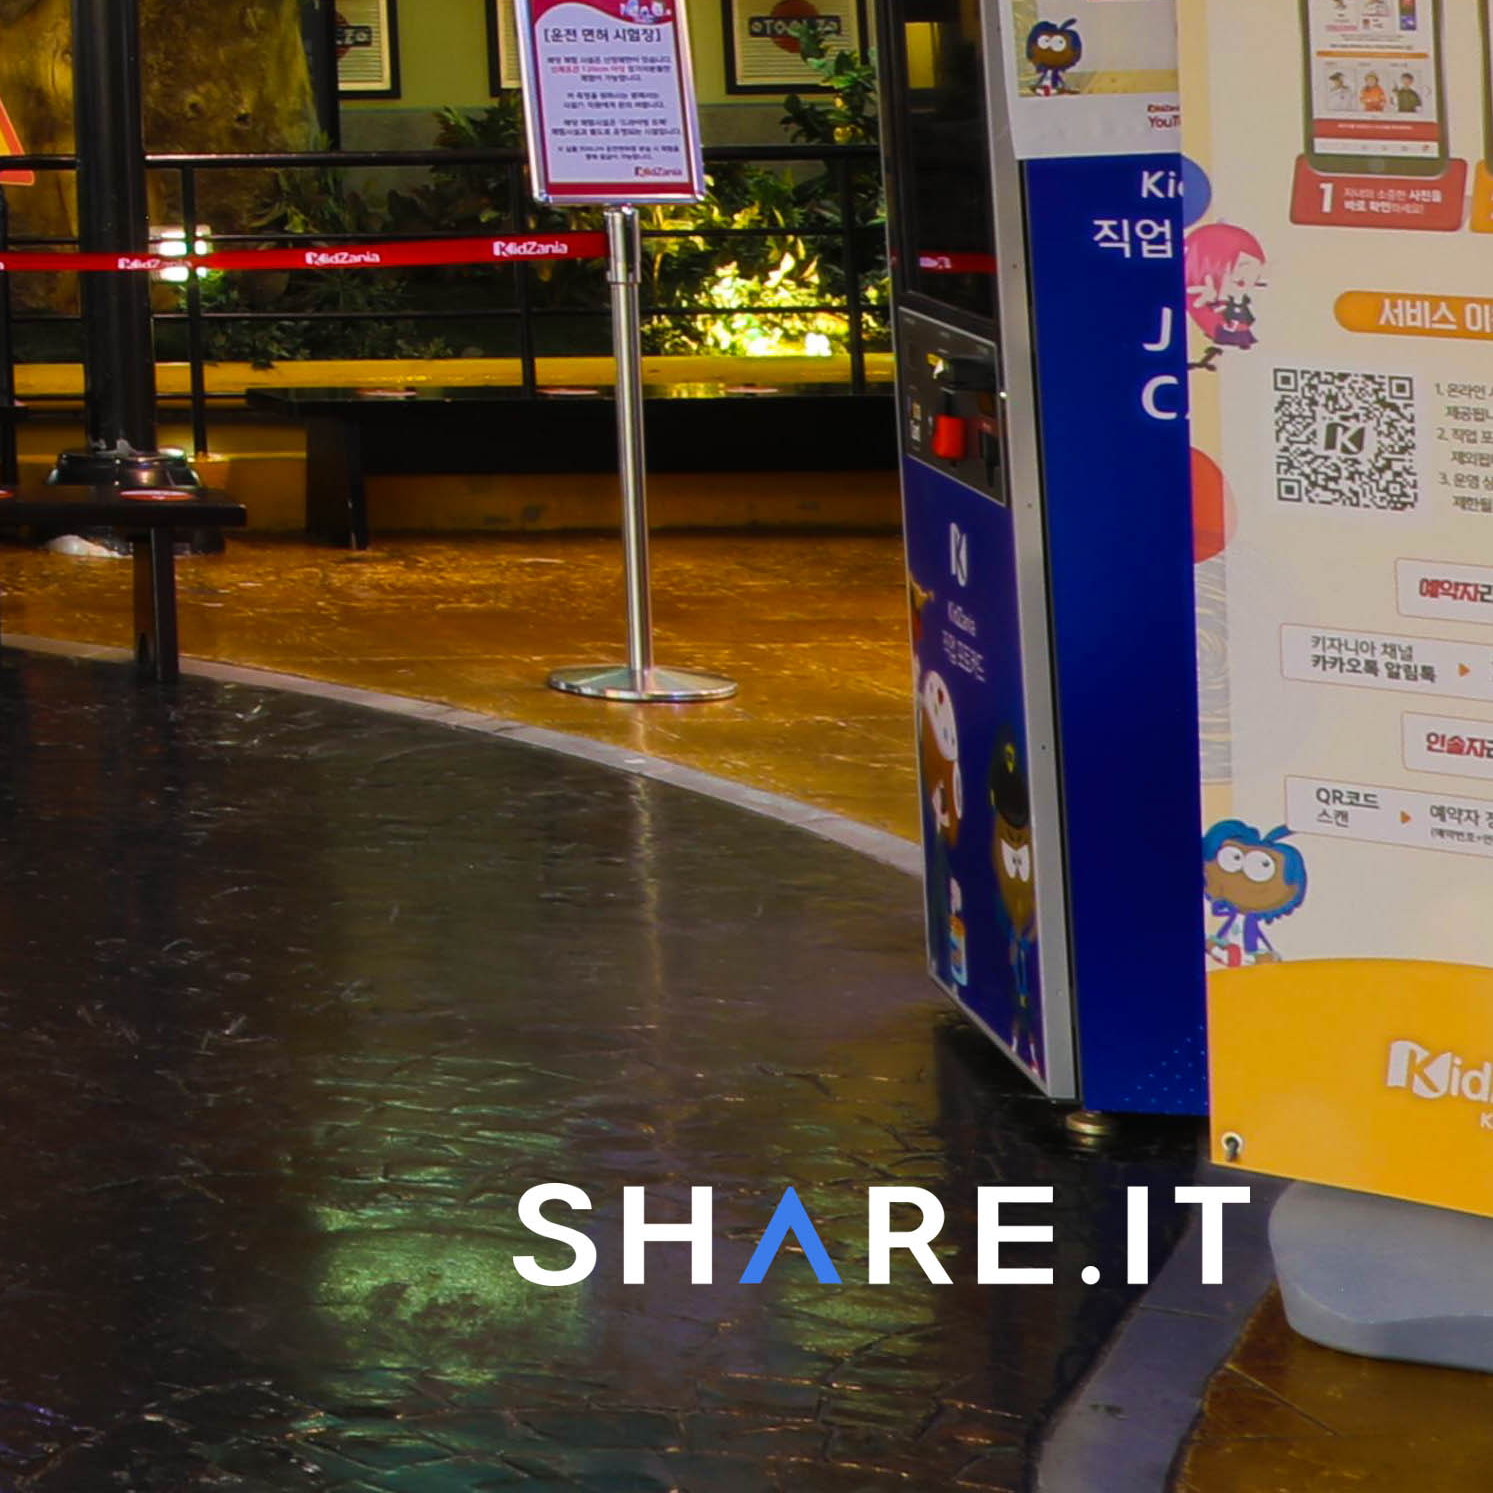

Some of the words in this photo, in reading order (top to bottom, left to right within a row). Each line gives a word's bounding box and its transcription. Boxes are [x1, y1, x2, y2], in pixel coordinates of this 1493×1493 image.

[581, 27, 610, 43] 면허
[1319, 182, 1334, 214] 1
[493, 240, 569, 258] KidZania
[1092, 218, 1174, 259] 직업
[305, 250, 381, 267] KidZania
[1378, 297, 1458, 331] 서비스
[1446, 382, 1486, 400] 온라인
[1450, 427, 1478, 445] 직업
[1453, 473, 1480, 490] 운영
[1310, 634, 1377, 656] 키자니아
[1380, 640, 1415, 661] 채널
[1310, 654, 1380, 678] 카카오톡
[1383, 660, 1437, 684] 알림톡
[1315, 787, 1381, 811] QR코드
[1315, 810, 1350, 829] 스캔
[1429, 804, 1480, 827] 예약자
[1386, 1039, 1493, 1104] Kid
